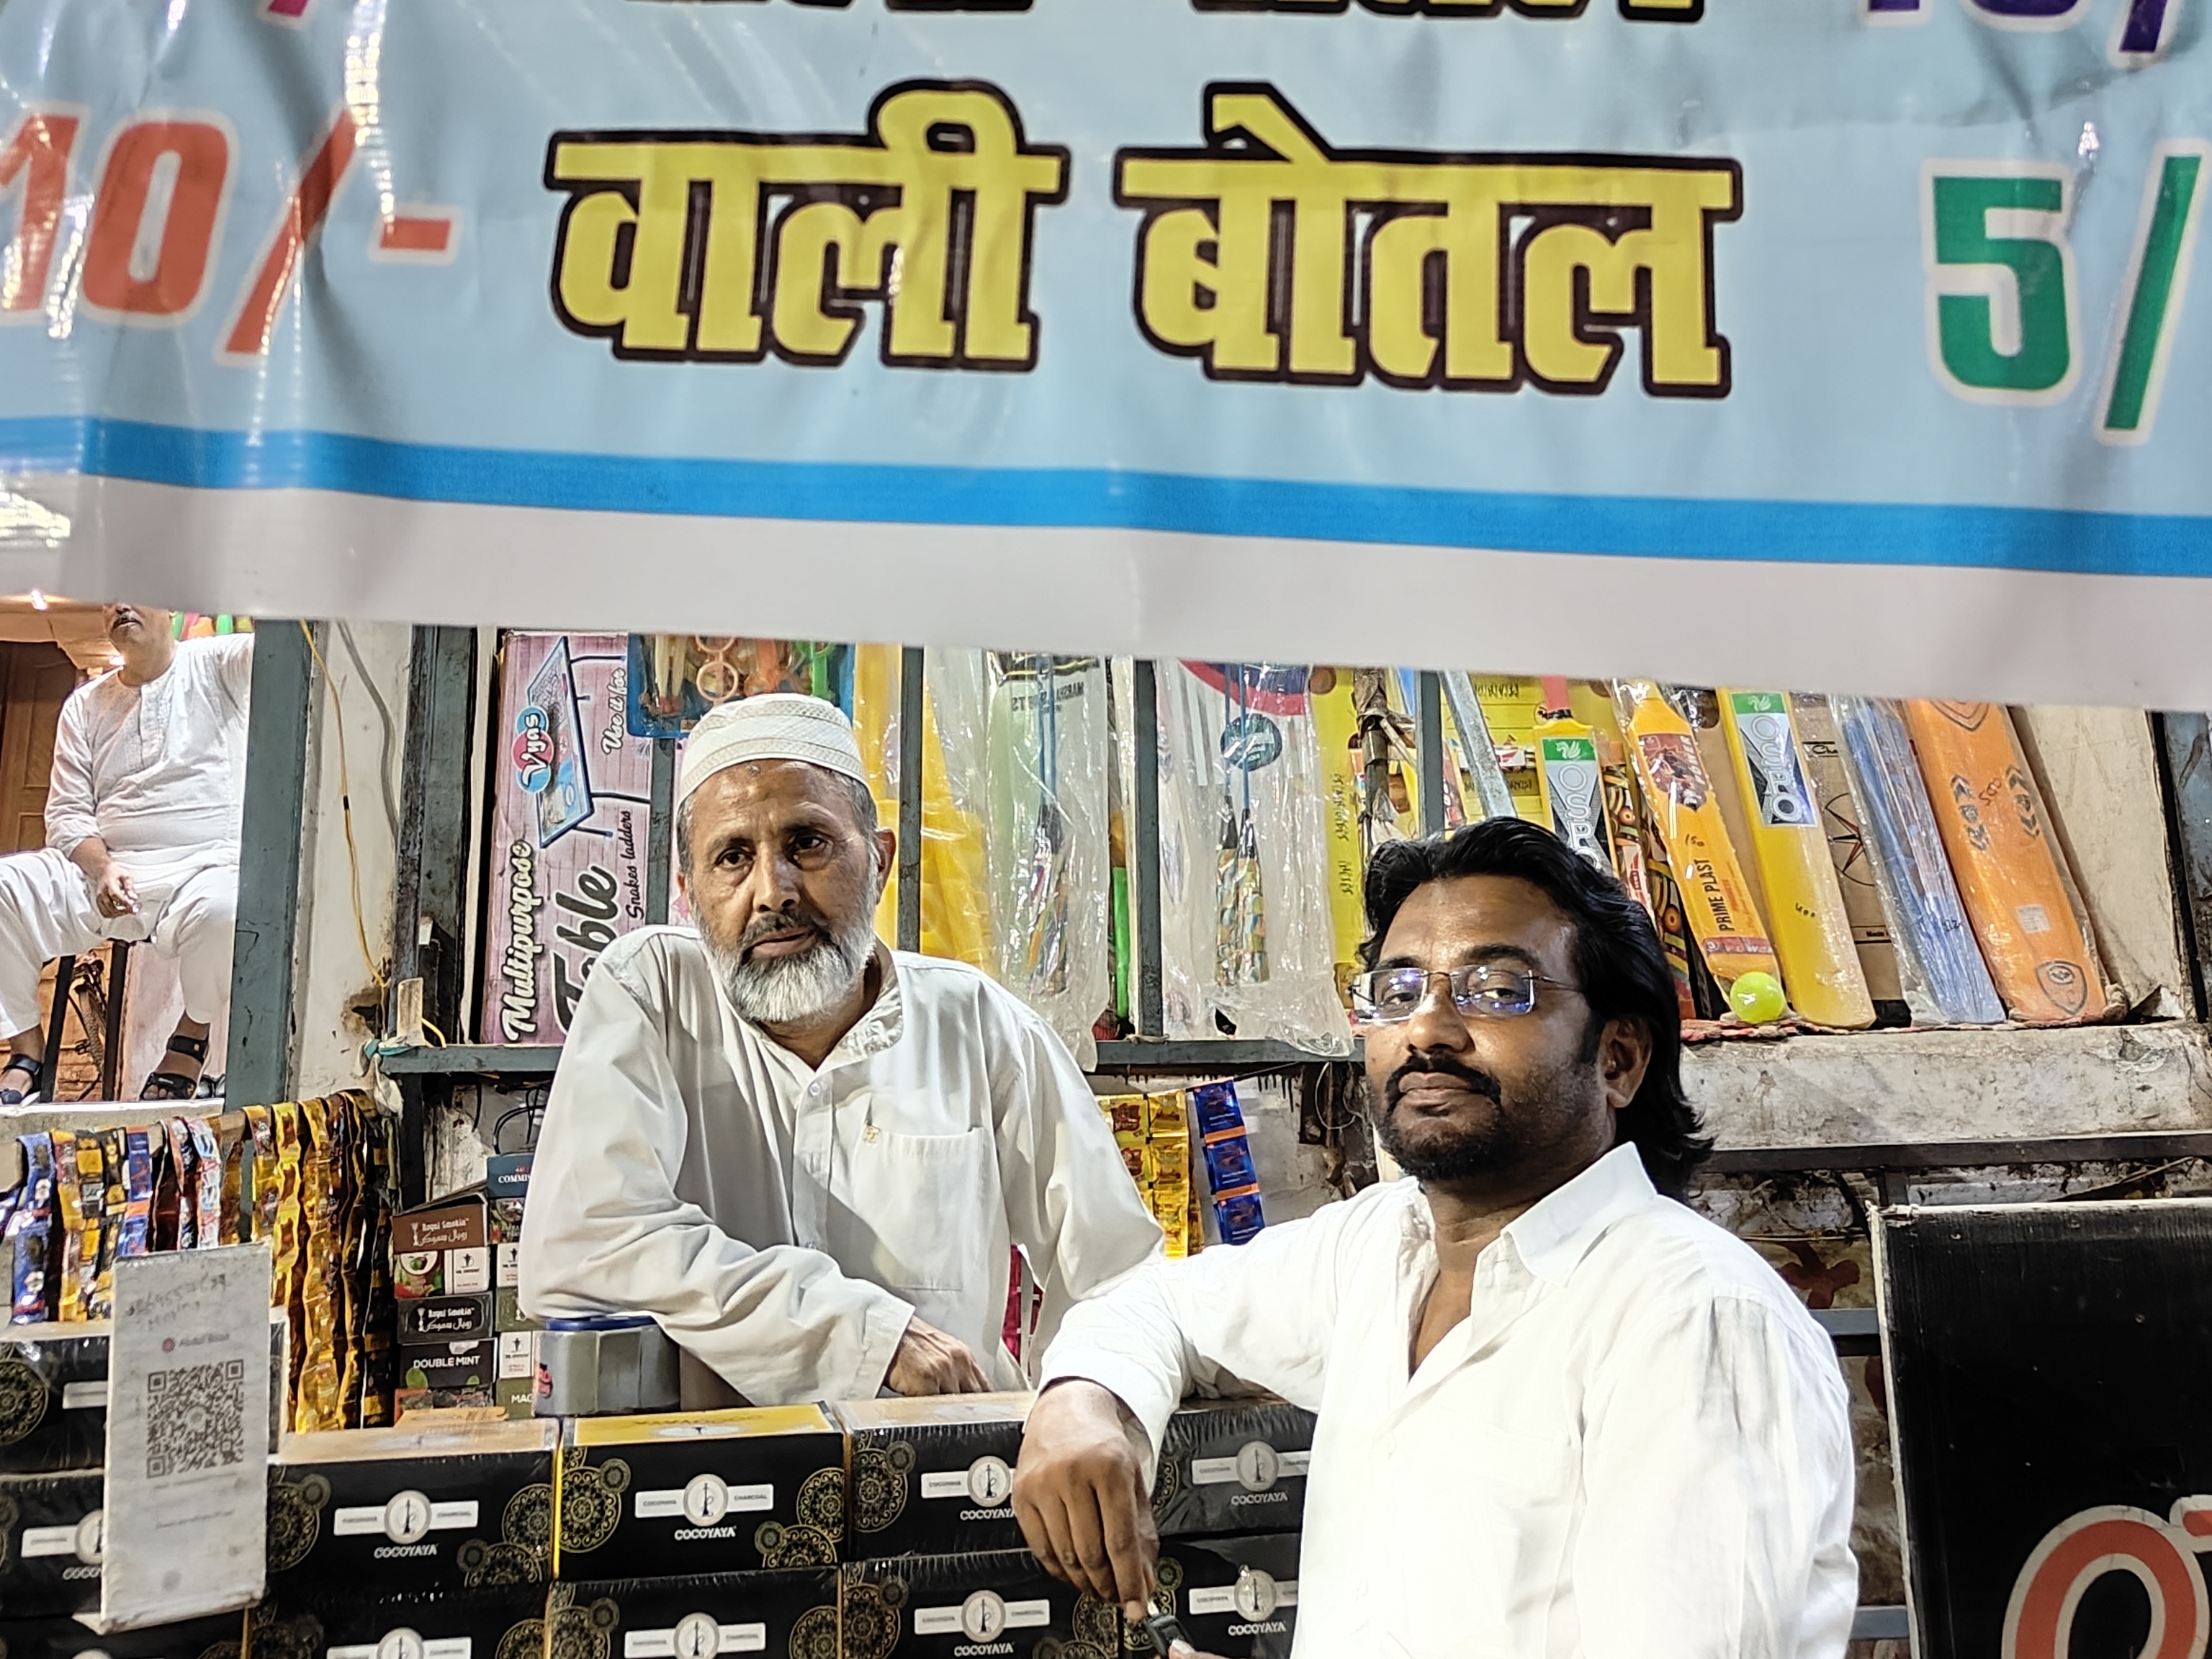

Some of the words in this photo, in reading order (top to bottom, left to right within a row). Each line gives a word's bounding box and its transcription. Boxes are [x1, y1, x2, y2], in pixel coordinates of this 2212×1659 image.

[544, 78, 1070, 373] वाली
[1114, 81, 1743, 398] बोतल
[521, 713, 548, 786] Vyas
[601, 714, 625, 754] Use
[1979, 778, 2002, 806] 500
[620, 810, 636, 861] ladders
[624, 866, 644, 920] Snakes
[1694, 858, 1721, 893] PLAST
[1707, 893, 1735, 932] PRIME
[500, 839, 544, 1041] Multipurpose
[413, 1358, 454, 1369] DOUBLE
[455, 1355, 480, 1367] MINT
[1231, 1492, 1288, 1506] COCOYAYA
[374, 1544, 437, 1559] COCOYAYA
[674, 1527, 736, 1541] COCOYAYA
[1228, 1622, 1287, 1637] COCOYAYA
[953, 1642, 1014, 1657] COCOYAYA
